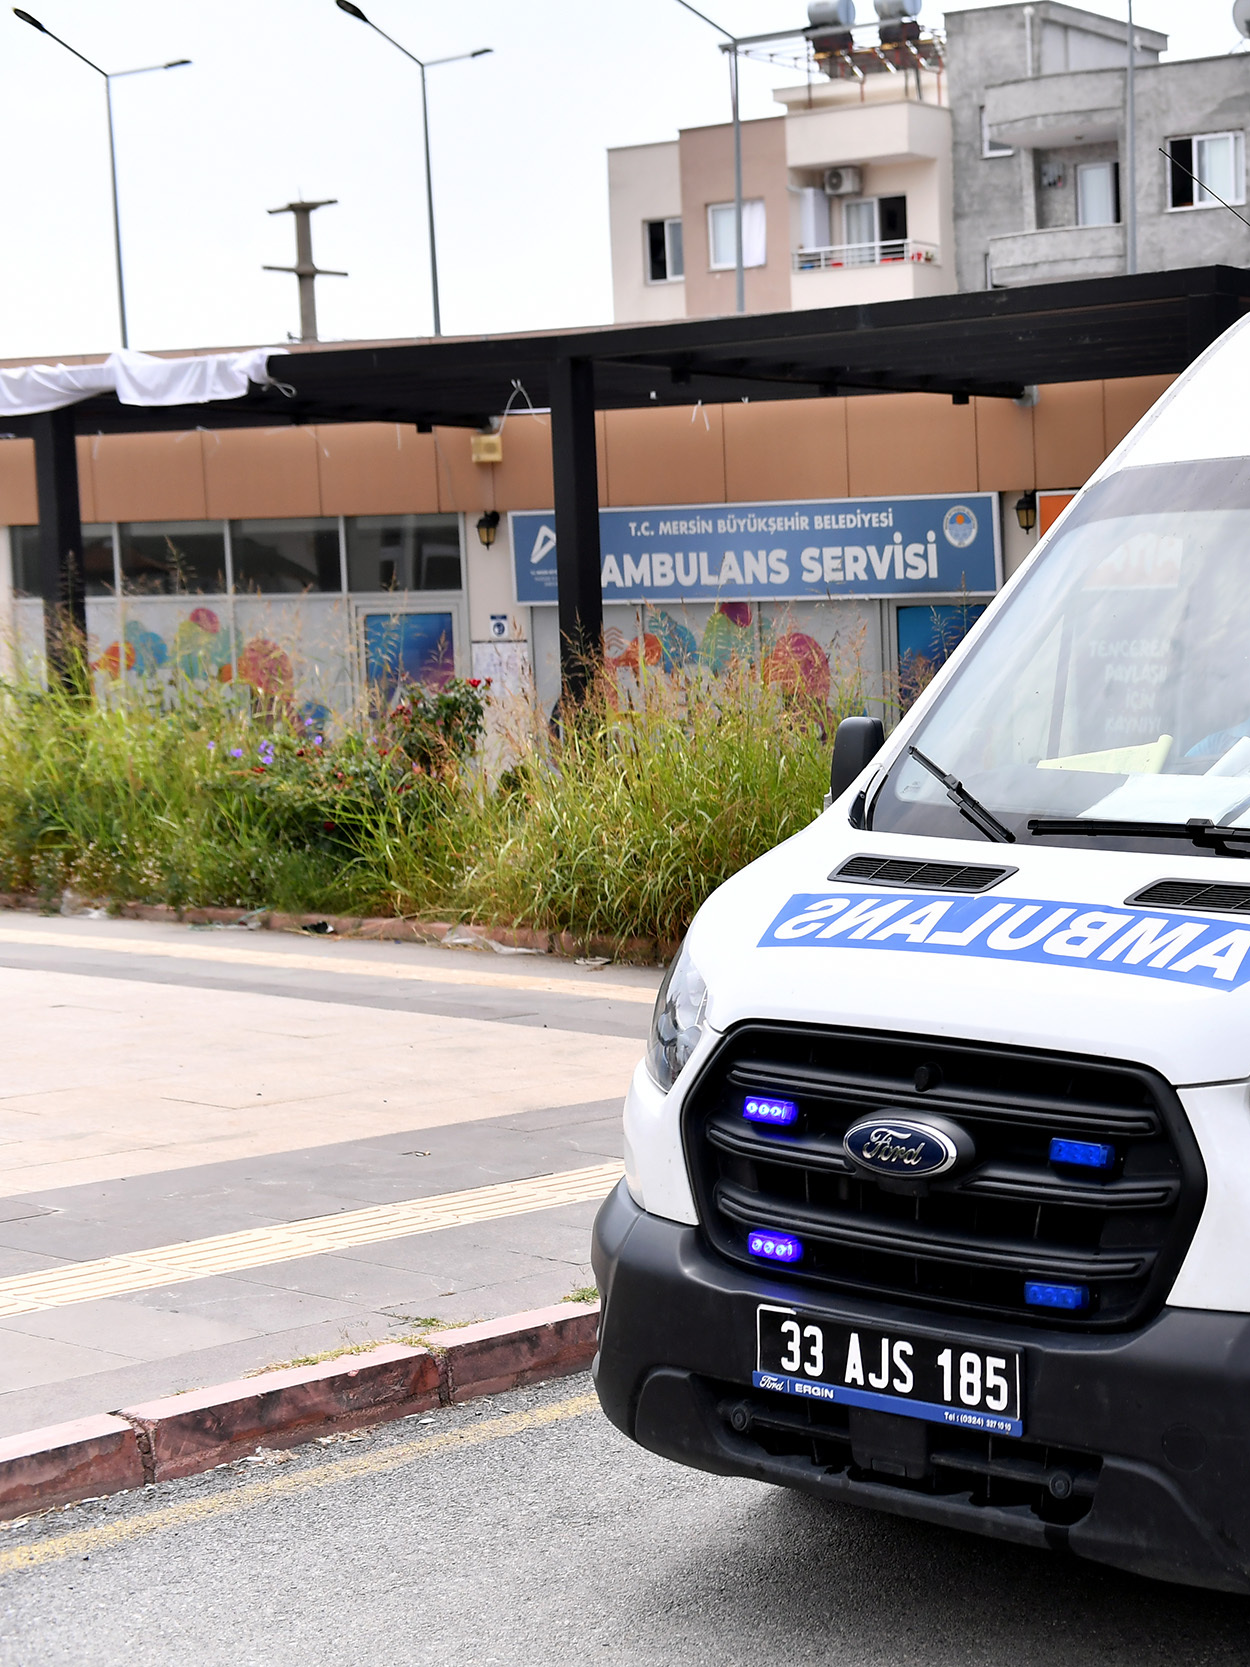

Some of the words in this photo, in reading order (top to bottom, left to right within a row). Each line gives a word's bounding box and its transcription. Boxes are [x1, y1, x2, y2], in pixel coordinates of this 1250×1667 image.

[629, 521, 655, 537] T.C.
[658, 515, 714, 536] MERSİN
[717, 511, 810, 535] BÜYÜKŞEHİR
[813, 507, 894, 531] BELEDİYESİ
[601, 549, 791, 589] AMBULANS
[800, 530, 938, 584] SERVİSİ
[862, 1126, 926, 1166] Ford
[760, 1375, 784, 1391] Ford
[780, 1320, 824, 1377] 33
[844, 1332, 914, 1393] AJS
[937, 1348, 1008, 1411] 185
